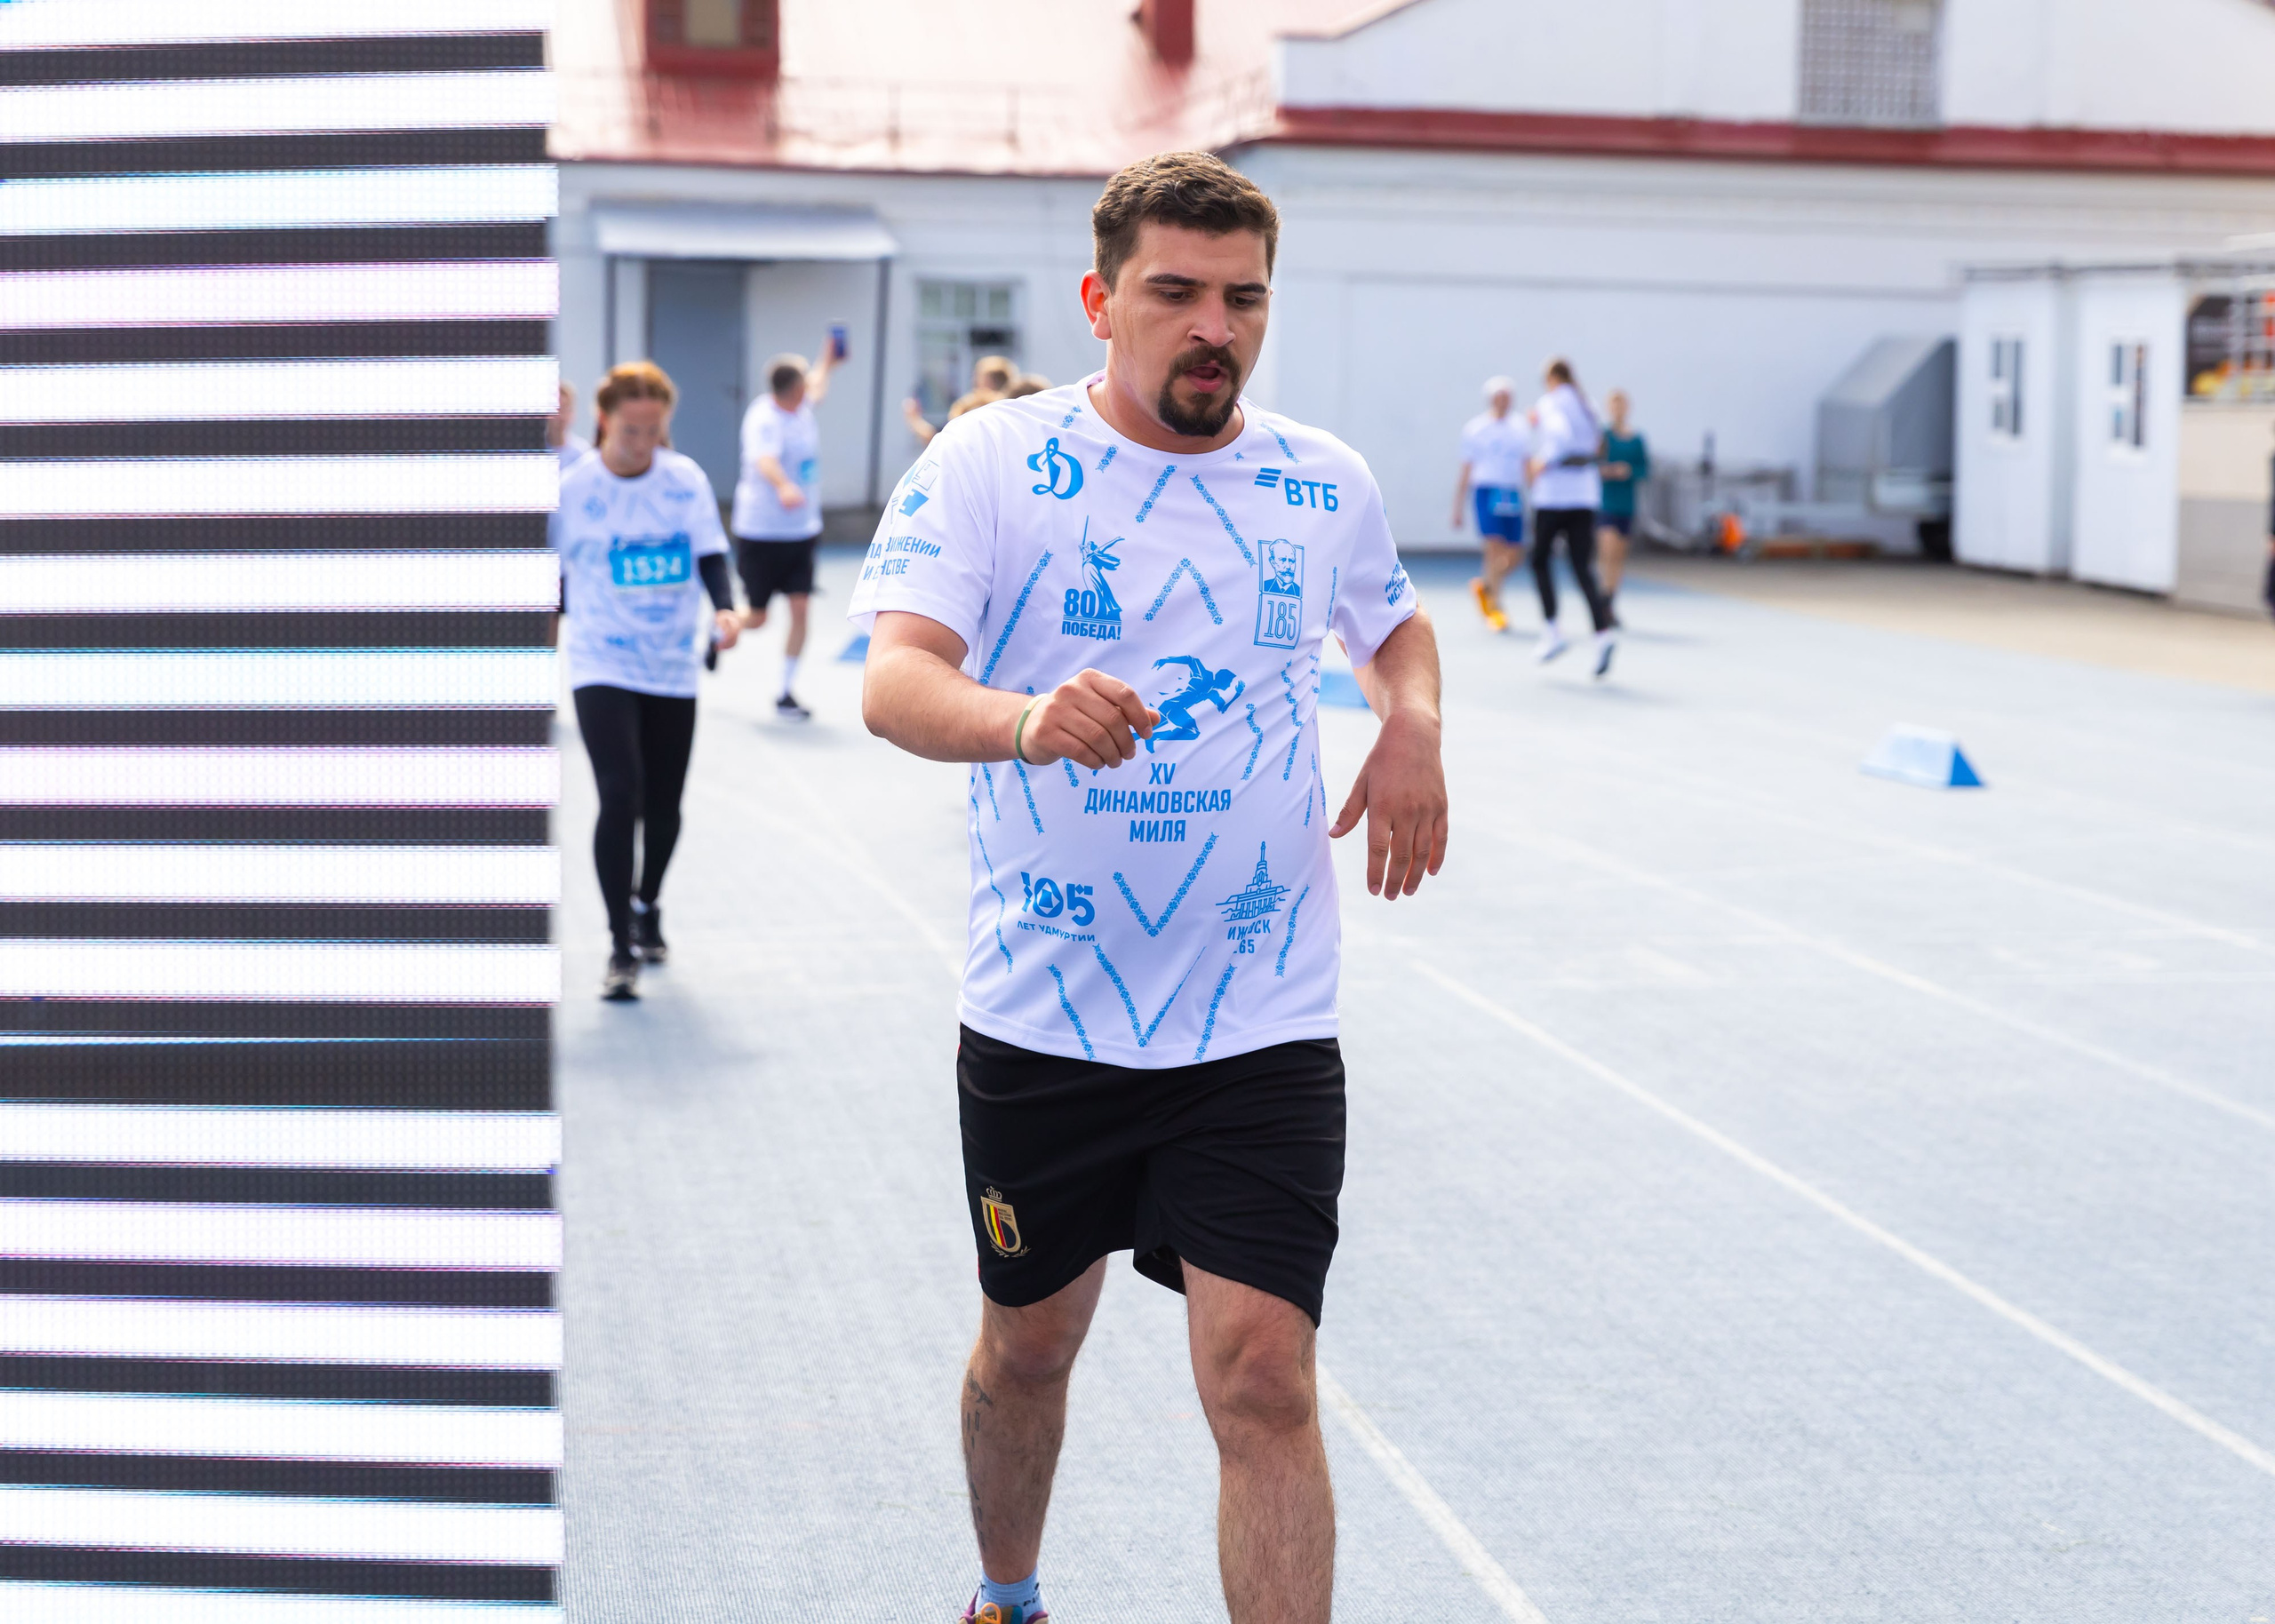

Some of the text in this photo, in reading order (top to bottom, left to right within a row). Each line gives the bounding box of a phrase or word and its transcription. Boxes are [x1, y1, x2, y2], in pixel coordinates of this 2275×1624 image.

[1284, 477, 1338, 513] ВТБ
[1064, 588, 1097, 618] 80
[1061, 620, 1122, 641] ПОБЕДА!
[1264, 600, 1297, 641] 185
[1148, 762, 1177, 784] XV
[1084, 788, 1232, 815] ДИНАМОВСКАЯ
[1130, 820, 1186, 843] МИЛЯ
[1018, 920, 1096, 942] ЛЕТ УДМУРТИИ
[1233, 939, 1255, 954] 65
